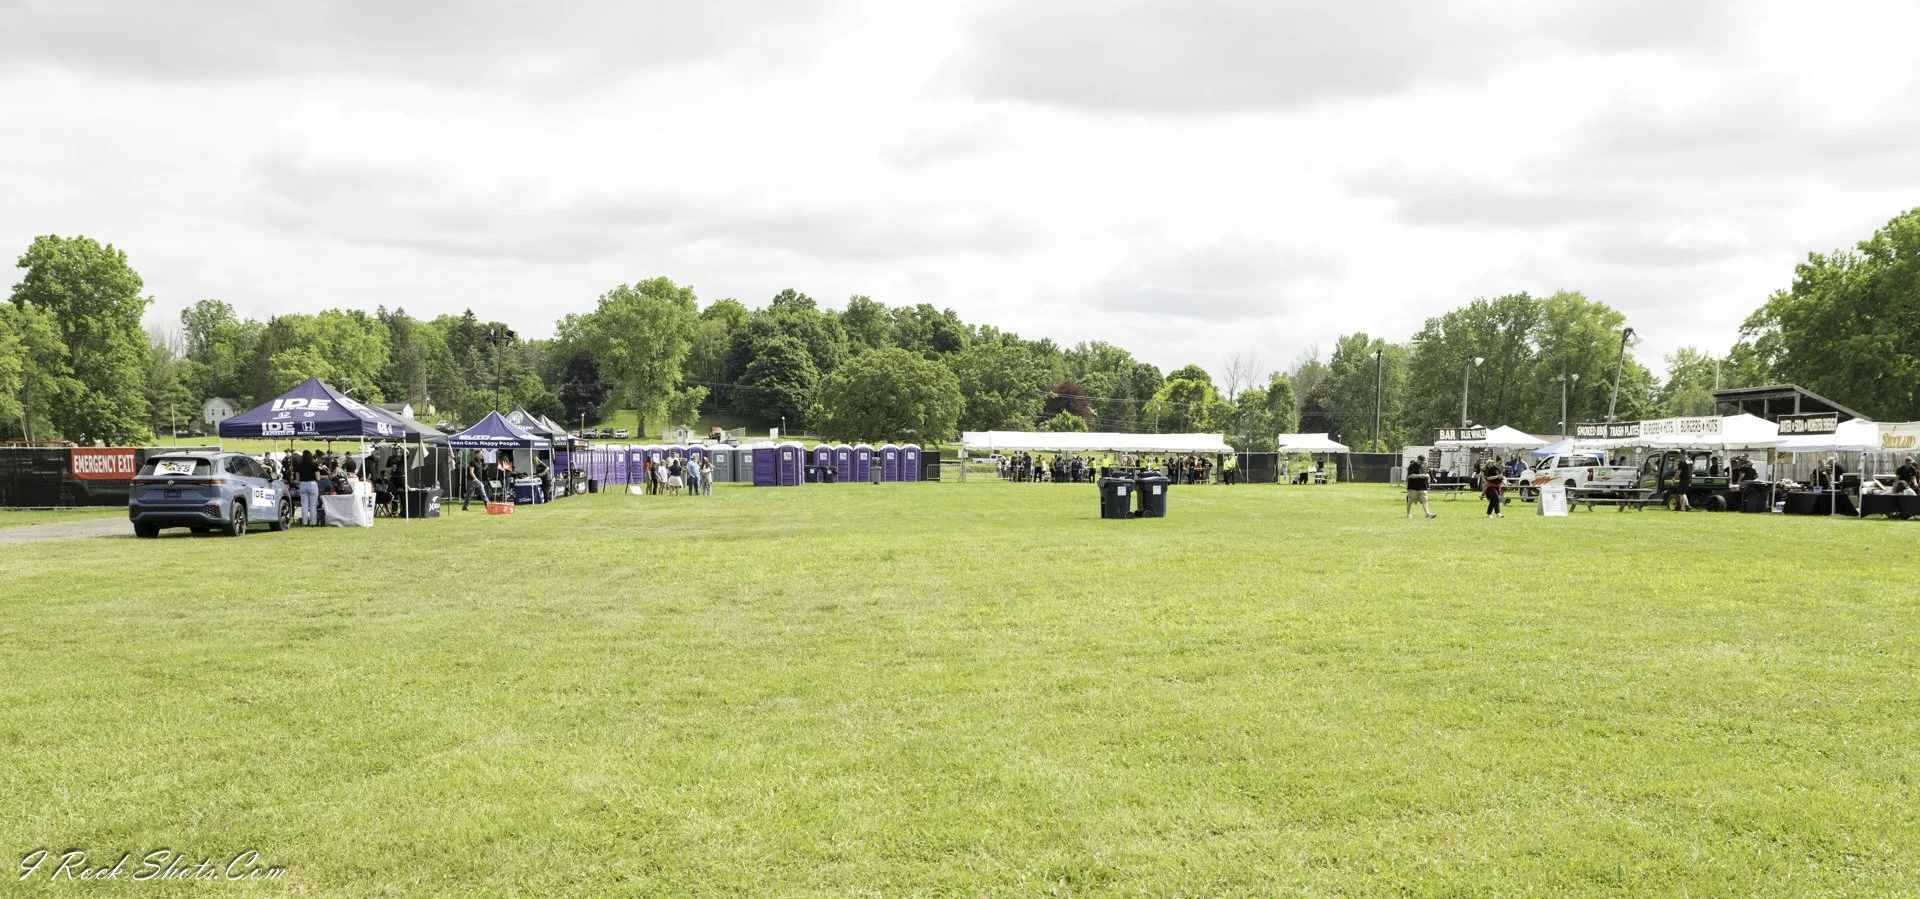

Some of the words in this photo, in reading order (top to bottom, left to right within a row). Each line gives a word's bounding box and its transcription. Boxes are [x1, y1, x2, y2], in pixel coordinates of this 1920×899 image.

[271, 398, 331, 409] IDE
[261, 421, 295, 431] IDE
[1609, 425, 1624, 437] TRASH
[1624, 425, 1640, 437] PLATES
[1643, 422, 1660, 435] BURGERS
[1680, 419, 1701, 433] BURGERS
[1706, 418, 1718, 432] HOTS
[1439, 429, 1456, 440] BAR
[1460, 430, 1472, 440] BLUE
[1576, 425, 1596, 437] SMOKED
[1596, 425, 1608, 438] BBQ
[73, 454, 117, 474] EMERGENCY
[117, 454, 135, 474] EXIT
[253, 489, 264, 499] IDE
